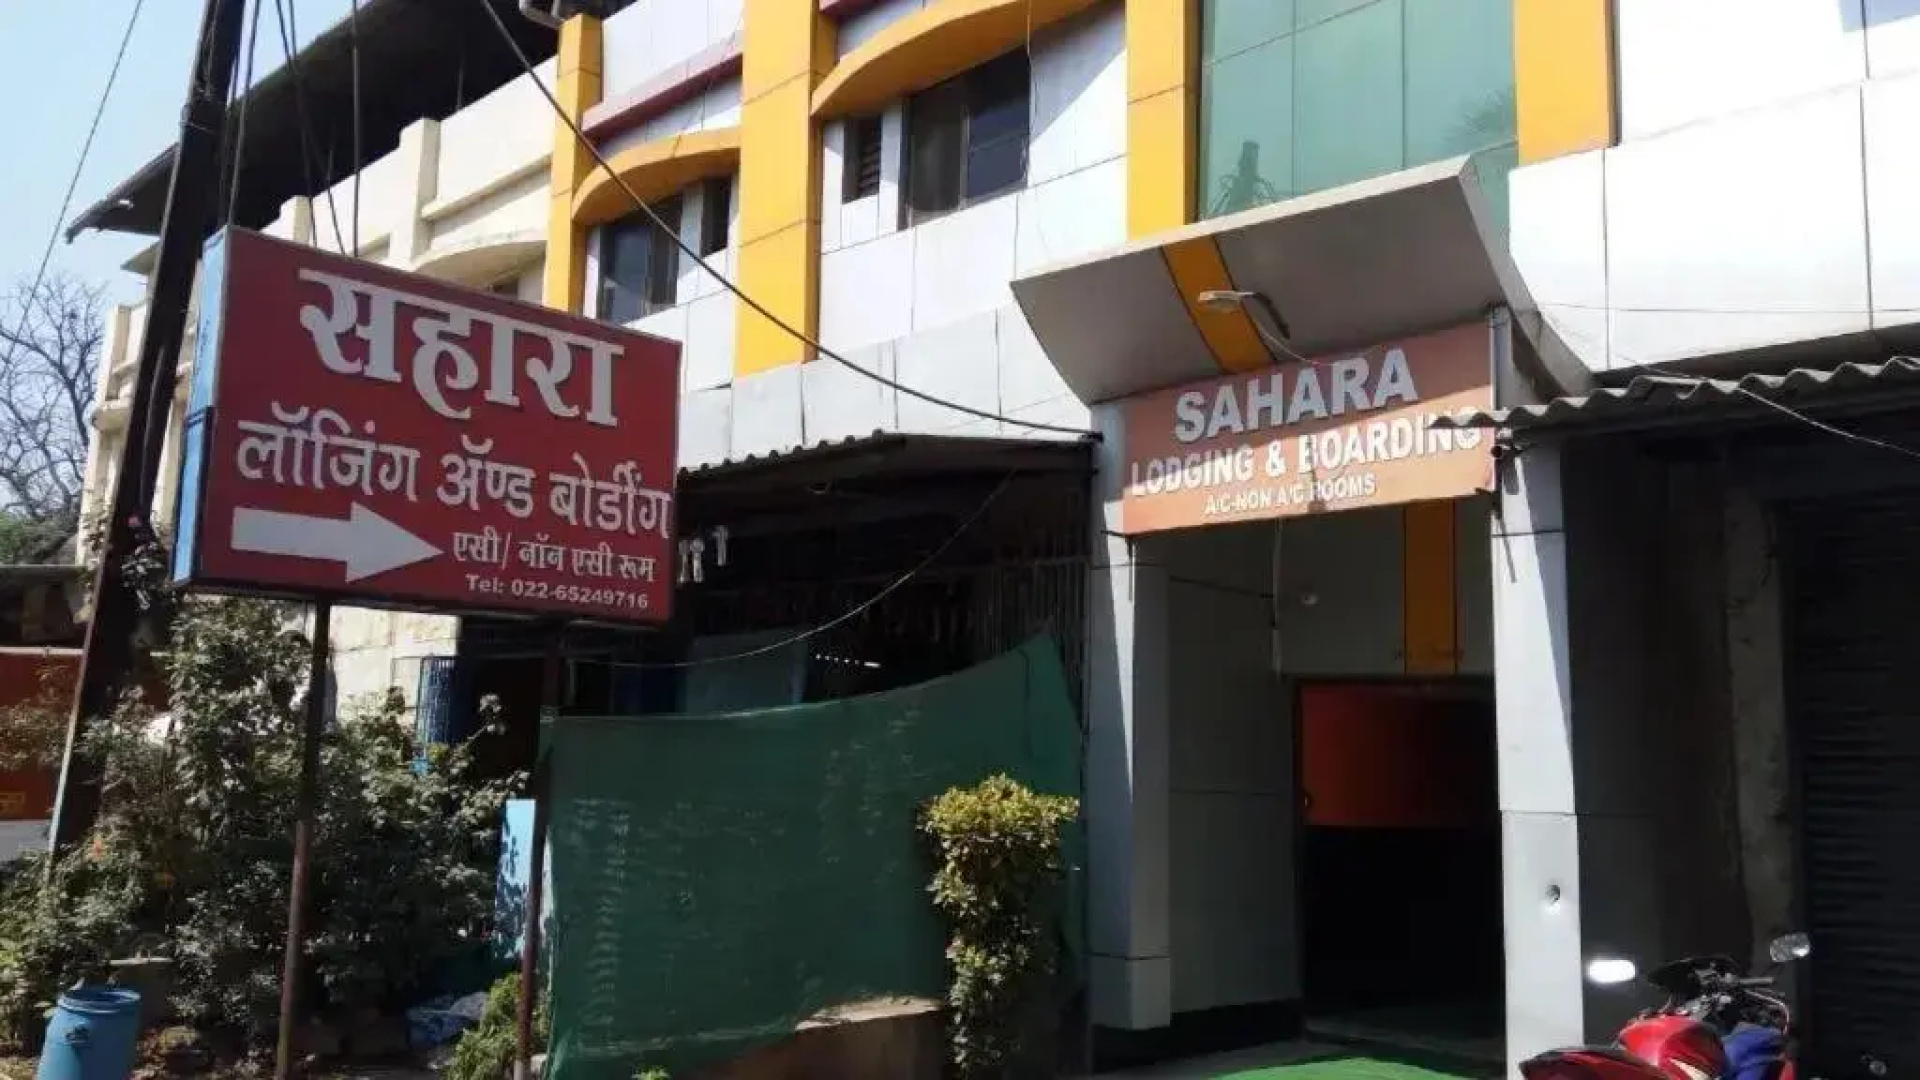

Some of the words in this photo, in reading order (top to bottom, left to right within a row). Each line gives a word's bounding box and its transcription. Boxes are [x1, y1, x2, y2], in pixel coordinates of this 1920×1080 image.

[299, 269, 625, 428] सहारा
[1174, 347, 1420, 443] SAHARA
[236, 401, 421, 502] लॉजिंग
[1131, 444, 1255, 496] LODGING
[1265, 439, 1287, 478] &
[1298, 406, 1483, 473] BOARDING
[1311, 471, 1376, 501] ROOMS
[465, 573, 504, 594] Tel:
[511, 578, 648, 609] 022-65249716
[518, 532, 567, 571] नॉन
[571, 541, 614, 577] एसी
[618, 554, 657, 582] रूम
